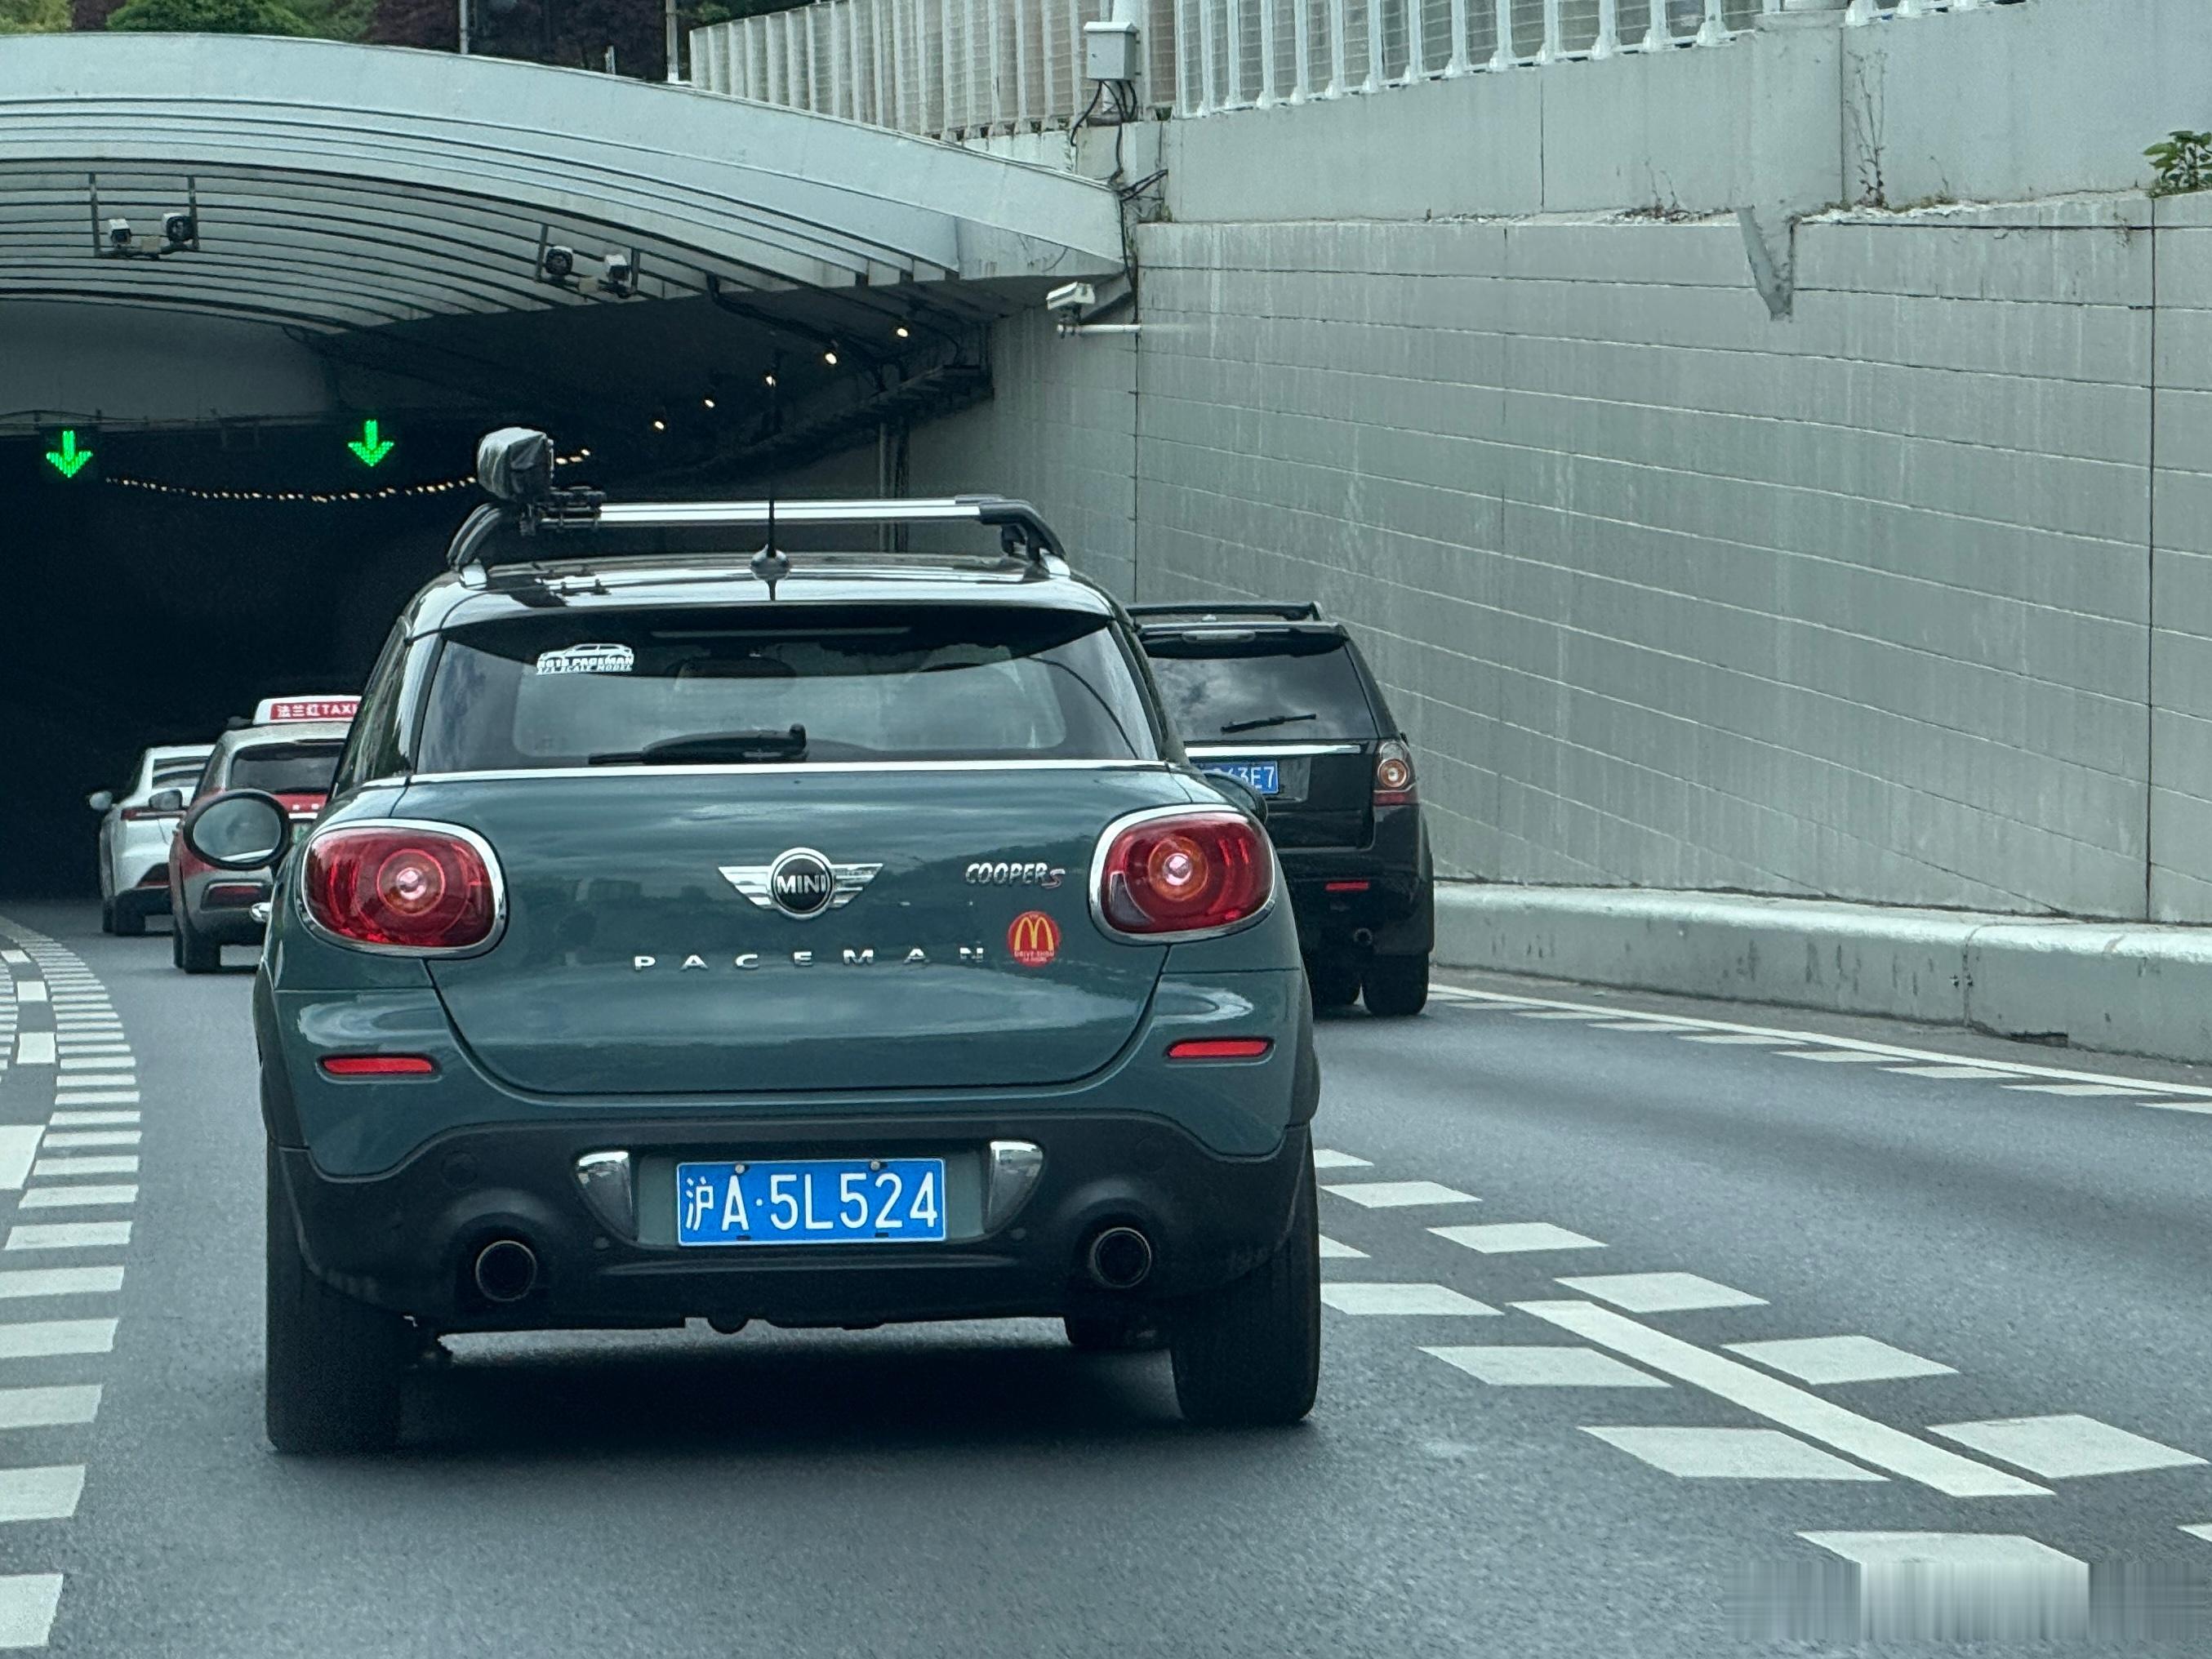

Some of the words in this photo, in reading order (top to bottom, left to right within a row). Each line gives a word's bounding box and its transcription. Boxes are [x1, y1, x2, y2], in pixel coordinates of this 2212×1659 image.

[777, 874, 826, 894] MINI
[634, 946, 985, 971] PACEMAN
[686, 1172, 938, 1230] 沪A·5L524
